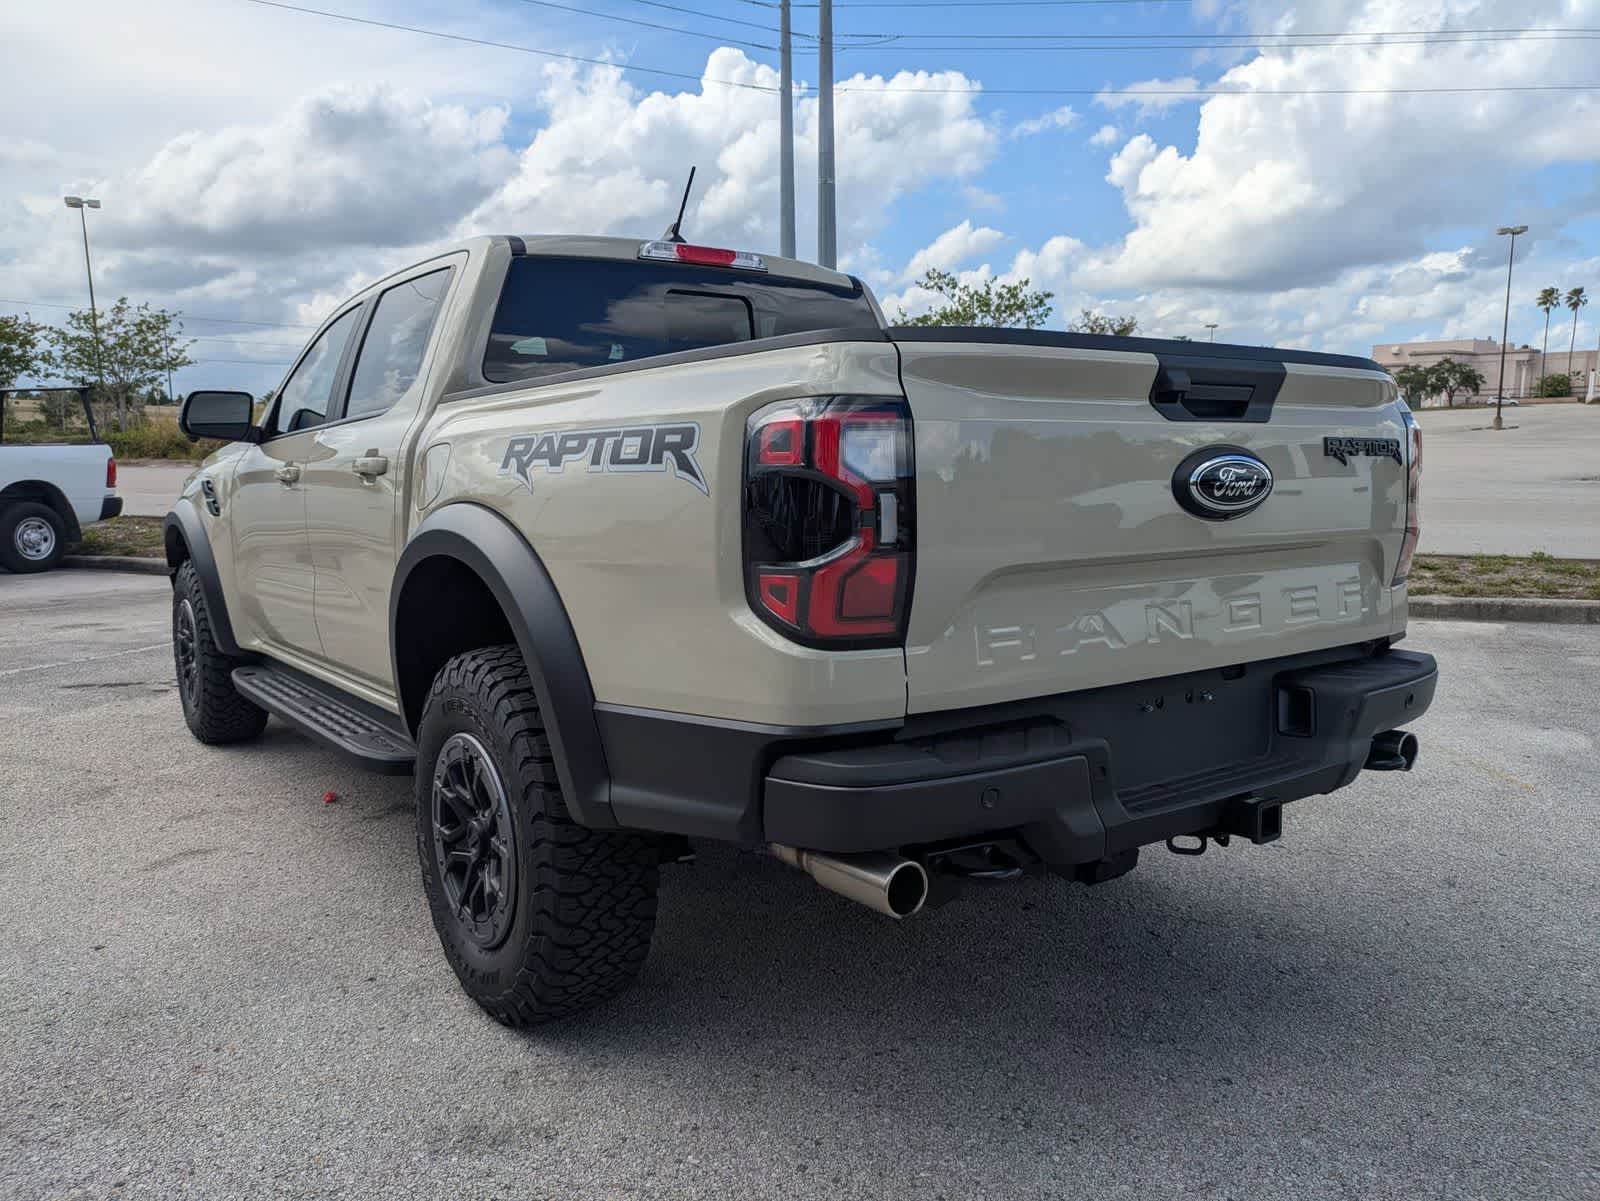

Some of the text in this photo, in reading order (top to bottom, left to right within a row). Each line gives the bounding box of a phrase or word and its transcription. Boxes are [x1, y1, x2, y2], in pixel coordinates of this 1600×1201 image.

[498, 422, 710, 496] RAPTOR
[1324, 437, 1402, 466] RAPTOR
[1214, 467, 1257, 497] Ford
